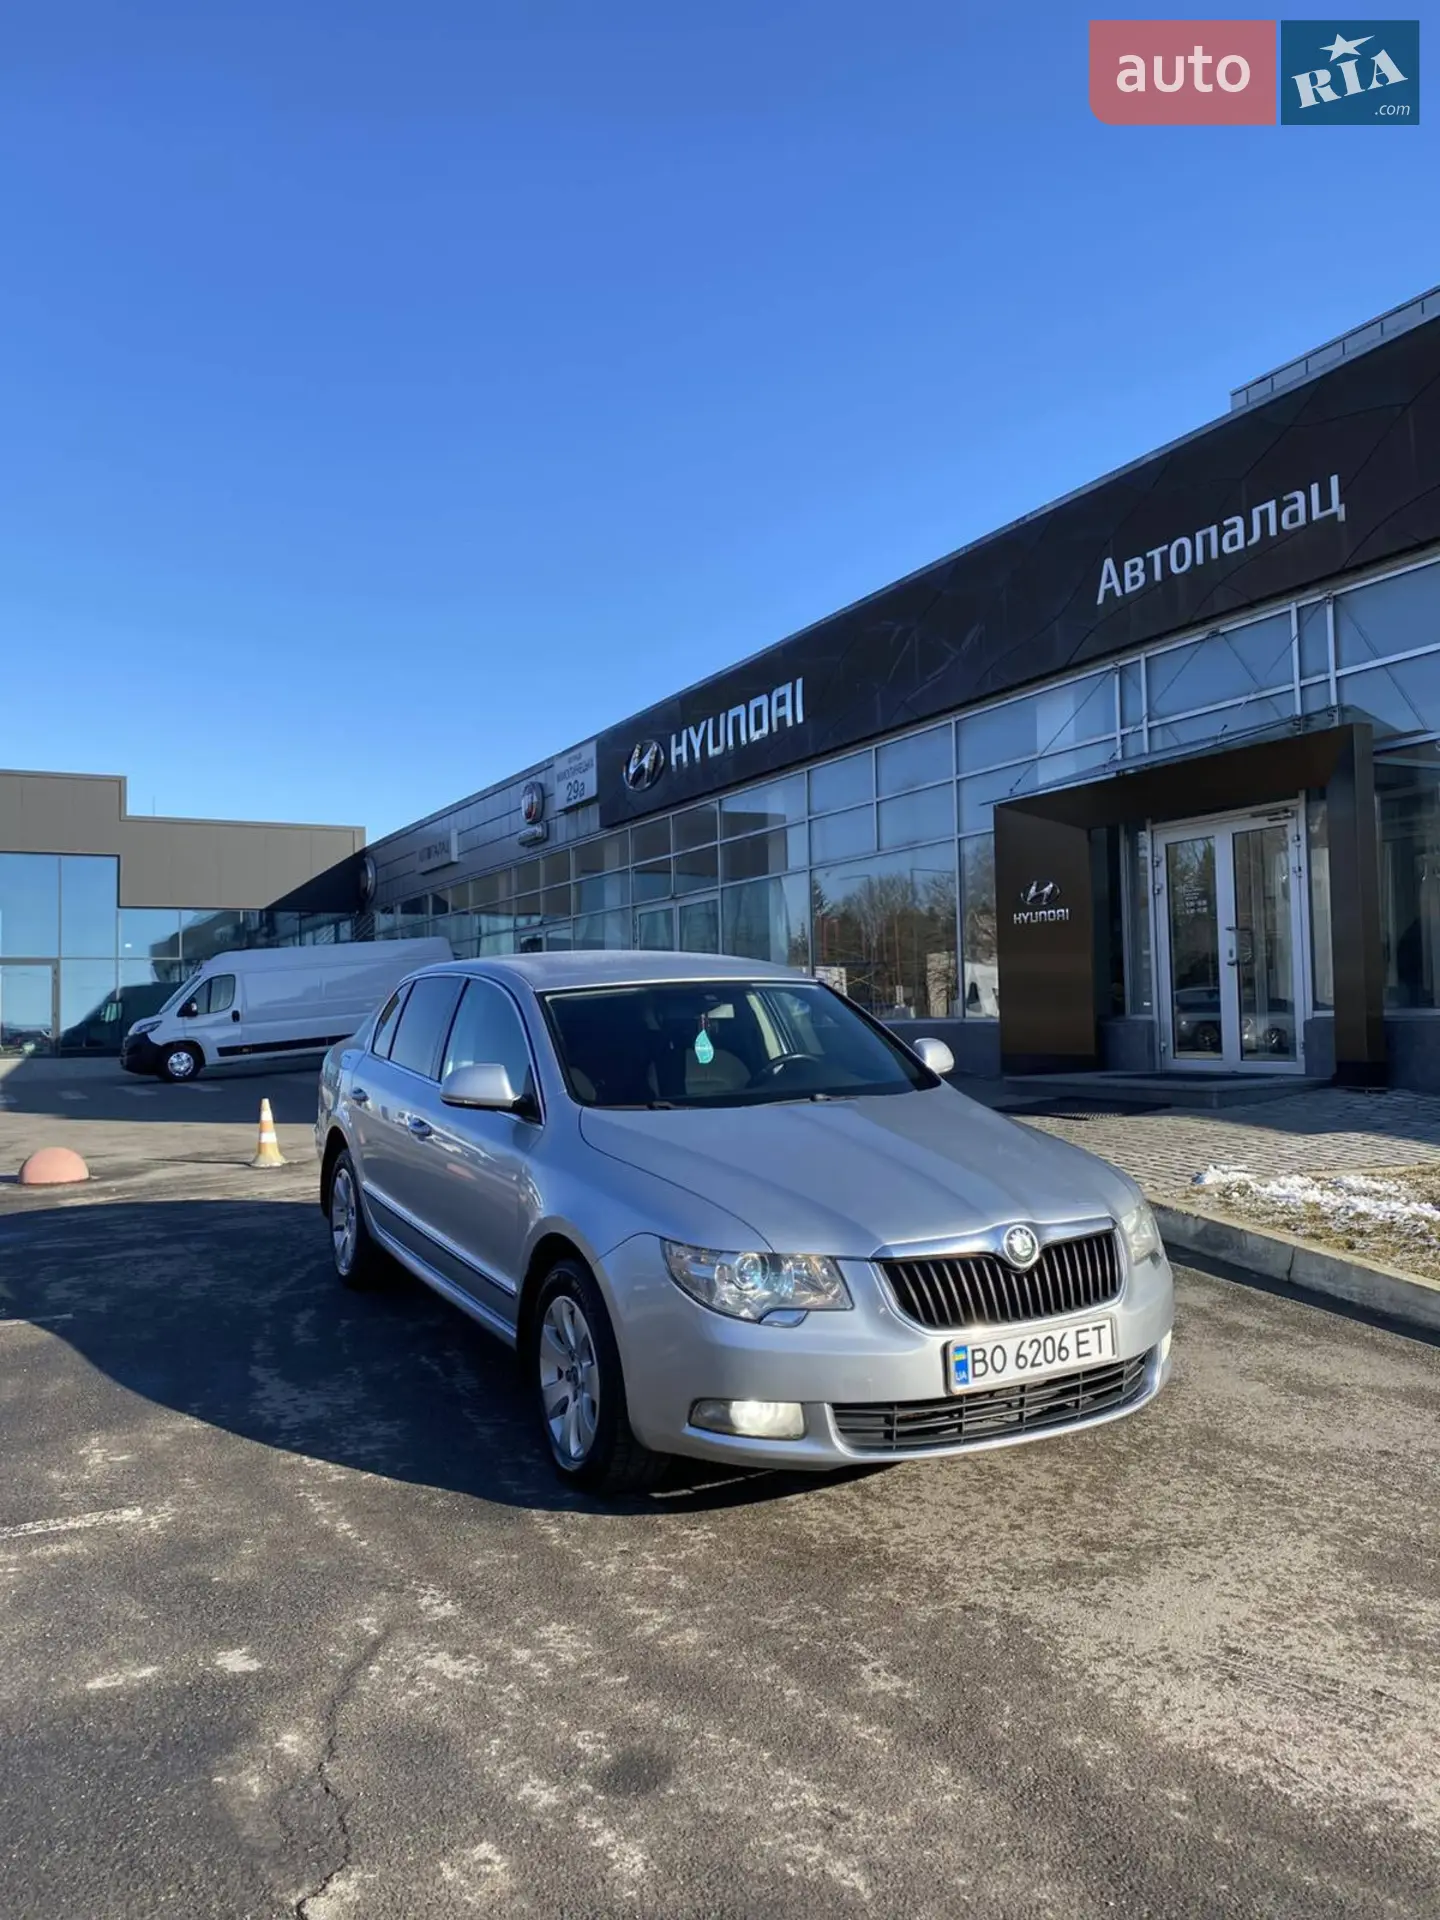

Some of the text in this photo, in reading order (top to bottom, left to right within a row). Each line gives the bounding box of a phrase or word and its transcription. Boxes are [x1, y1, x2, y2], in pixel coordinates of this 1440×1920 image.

[1096, 474, 1346, 605] Автопалац
[671, 677, 804, 772] HYUNDAI
[1013, 908, 1069, 925] HYUNDAI
[971, 1324, 1106, 1378] BO 6206 ET
